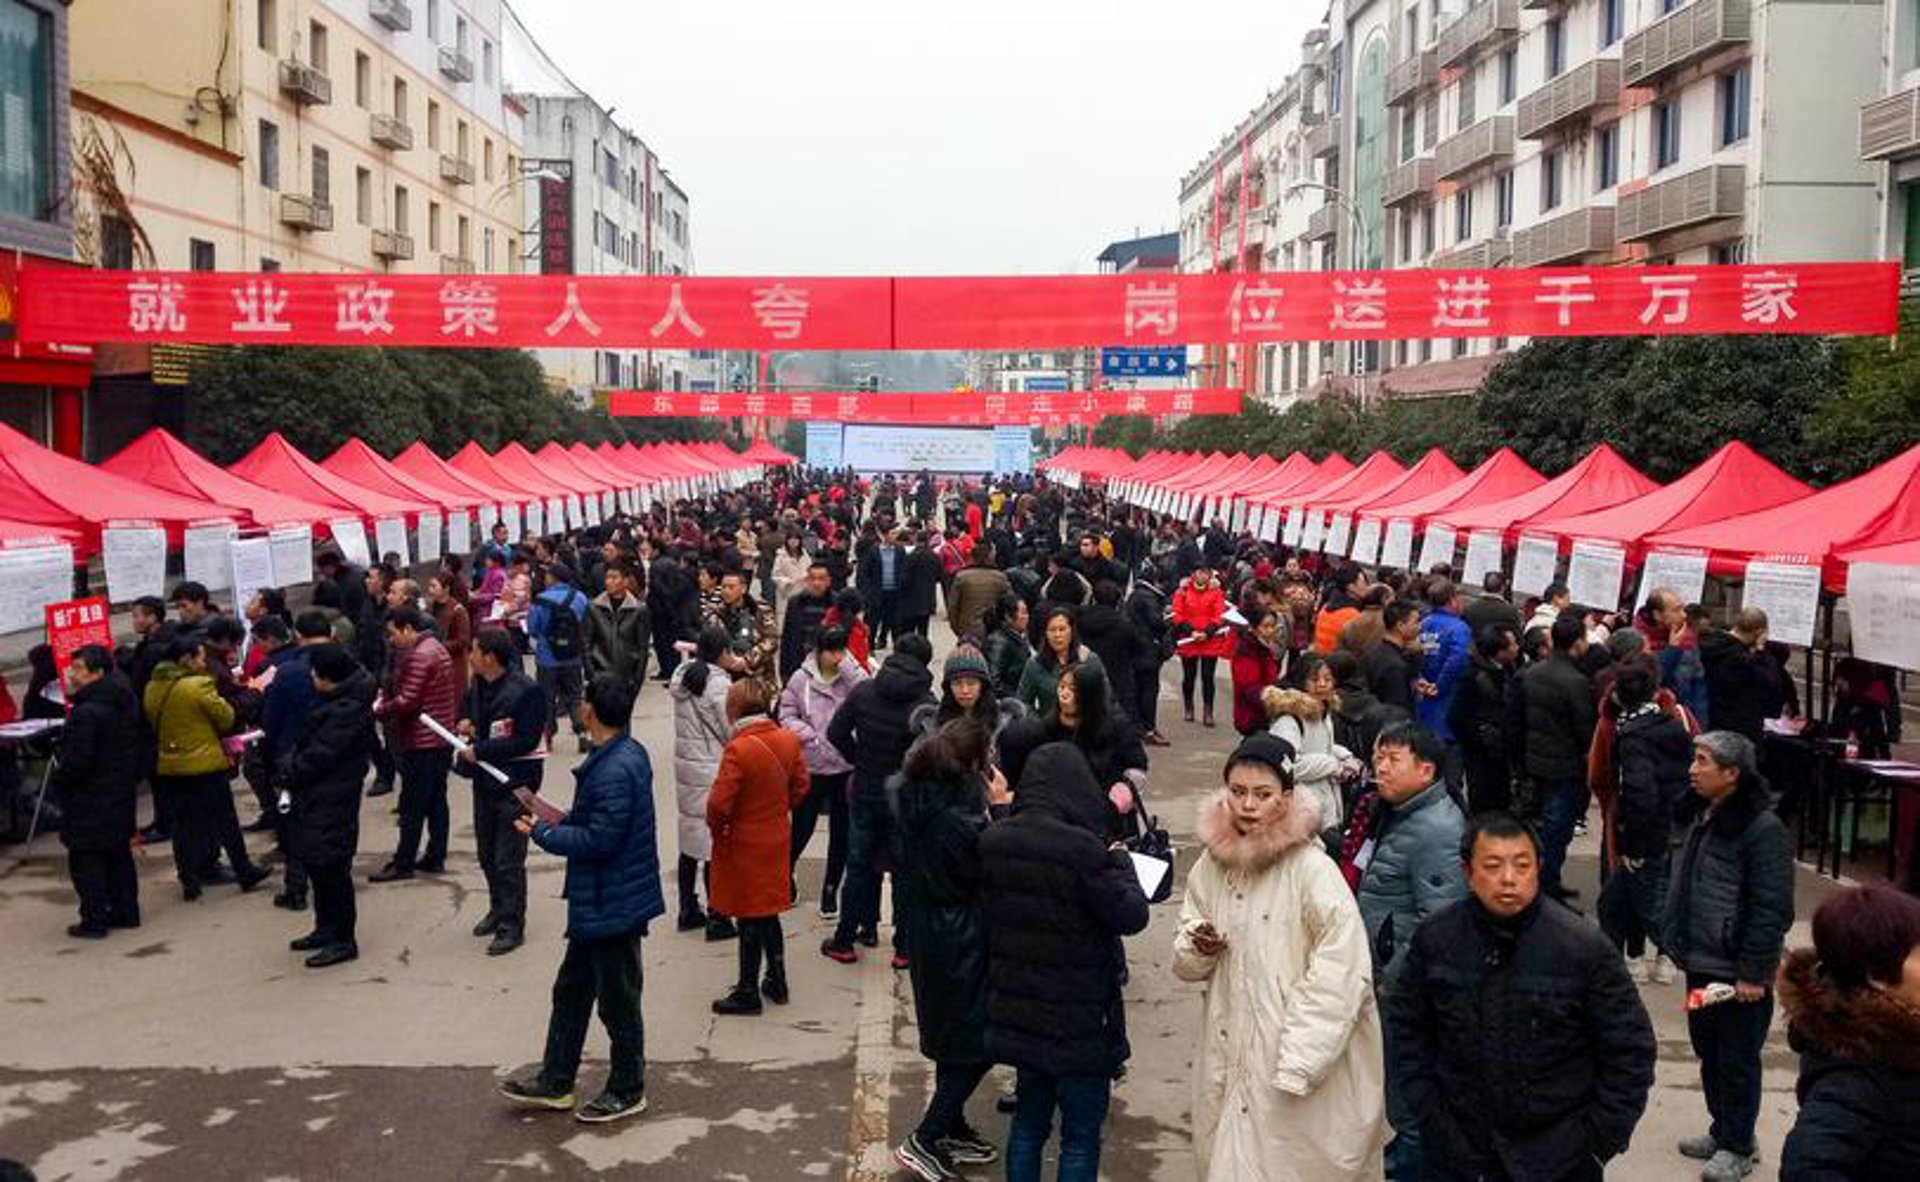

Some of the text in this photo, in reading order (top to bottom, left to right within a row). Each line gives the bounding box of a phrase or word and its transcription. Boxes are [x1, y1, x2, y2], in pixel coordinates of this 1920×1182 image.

[127, 272, 1799, 339] 就业政策人人夸 岗位送进千万家
